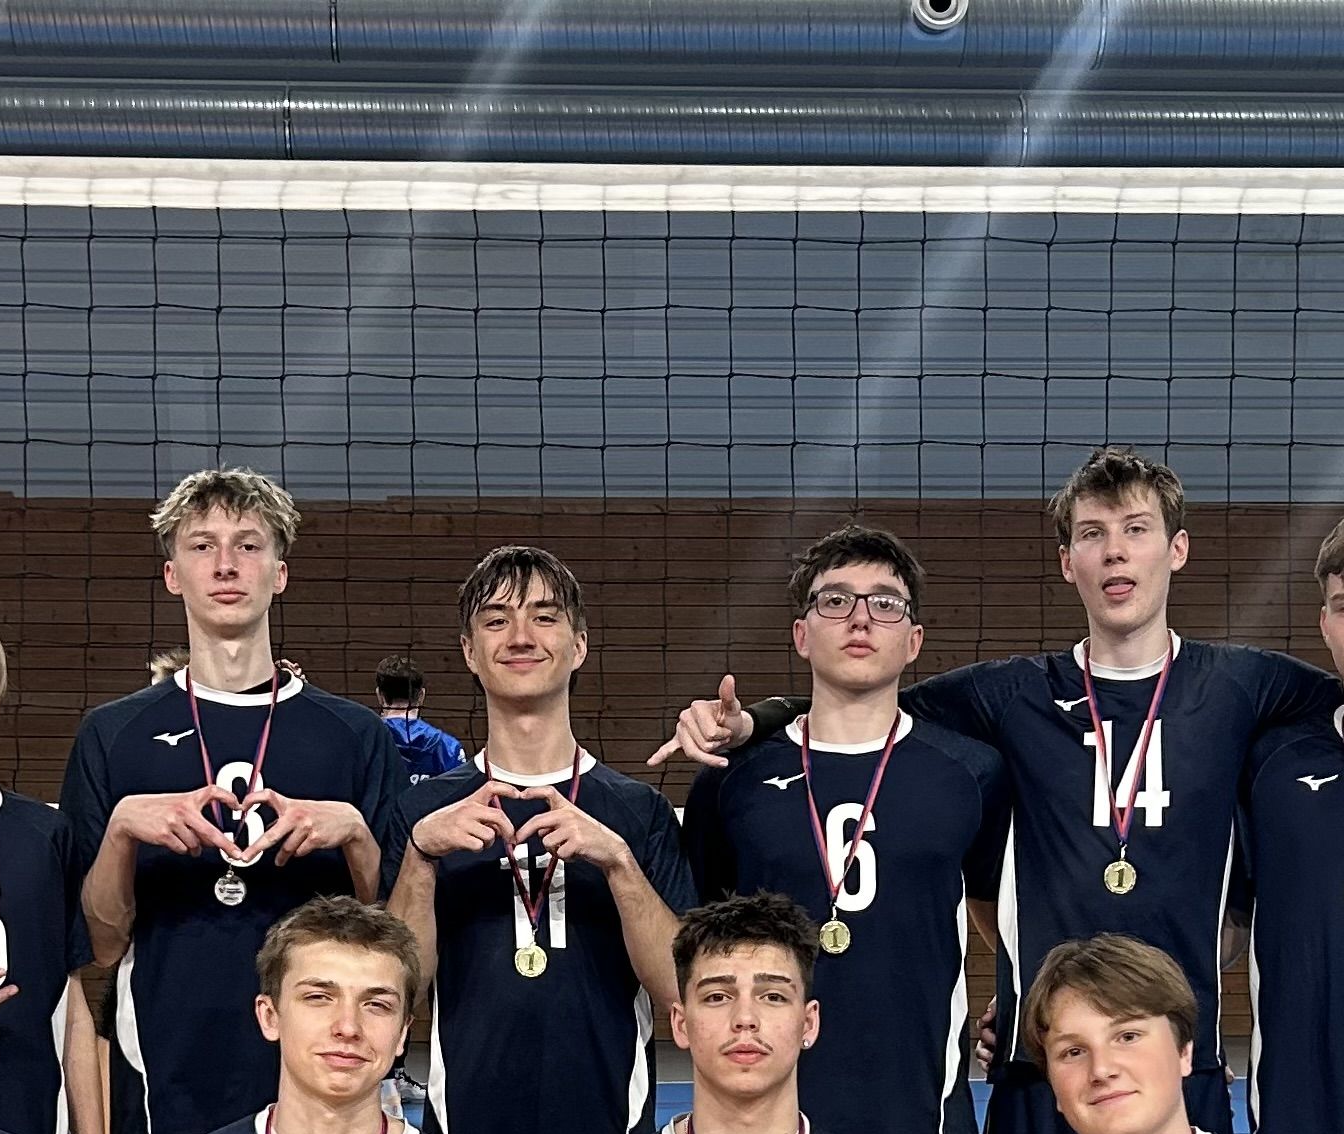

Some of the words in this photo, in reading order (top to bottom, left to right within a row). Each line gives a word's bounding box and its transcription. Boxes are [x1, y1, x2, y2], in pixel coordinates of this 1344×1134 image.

[1084, 719, 1170, 827] 14
[500, 843, 567, 949] 11
[826, 803, 876, 912] 6
